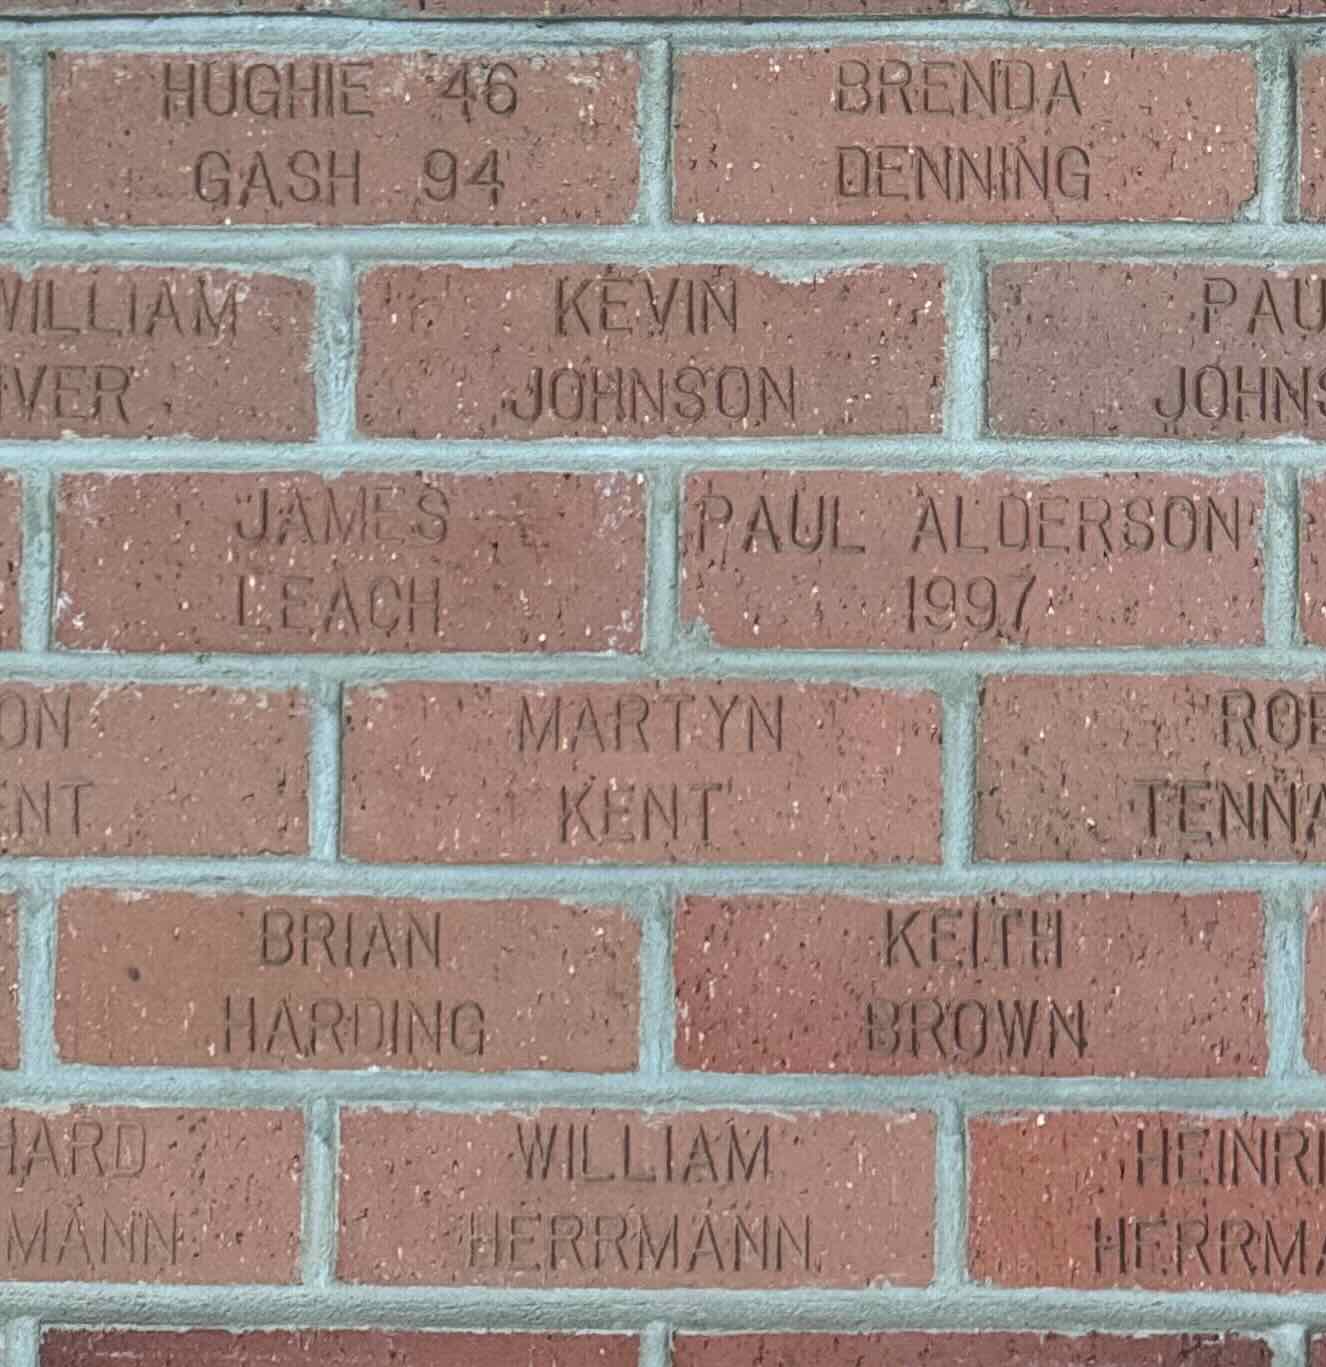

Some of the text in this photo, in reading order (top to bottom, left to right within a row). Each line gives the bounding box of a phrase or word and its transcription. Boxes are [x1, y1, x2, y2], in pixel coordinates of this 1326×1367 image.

[162, 60, 519, 122] HUGHIE 46
[834, 58, 1082, 117] BRENDA
[193, 148, 505, 207] GASH 94
[838, 145, 1091, 200] DENNING
[554, 277, 738, 336] KEVIN
[0, 364, 131, 423] VER
[510, 366, 796, 423] JOHNSON
[235, 487, 449, 546] JAMES
[693, 494, 1241, 554] PAUL ALDERSON
[233, 575, 442, 636] LEACH
[901, 575, 1038, 633] 1997
[516, 693, 783, 752] MARTYN
[0, 780, 94, 838] NT
[558, 783, 727, 842] KENT
[260, 910, 442, 969] BRIAN
[885, 908, 1064, 969] KEITH
[222, 997, 487, 1056] HARDING
[864, 998, 1087, 1059] BROWN
[516, 1122, 769, 1184] WILLIAM
[468, 1210, 813, 1272] HERRMANN
